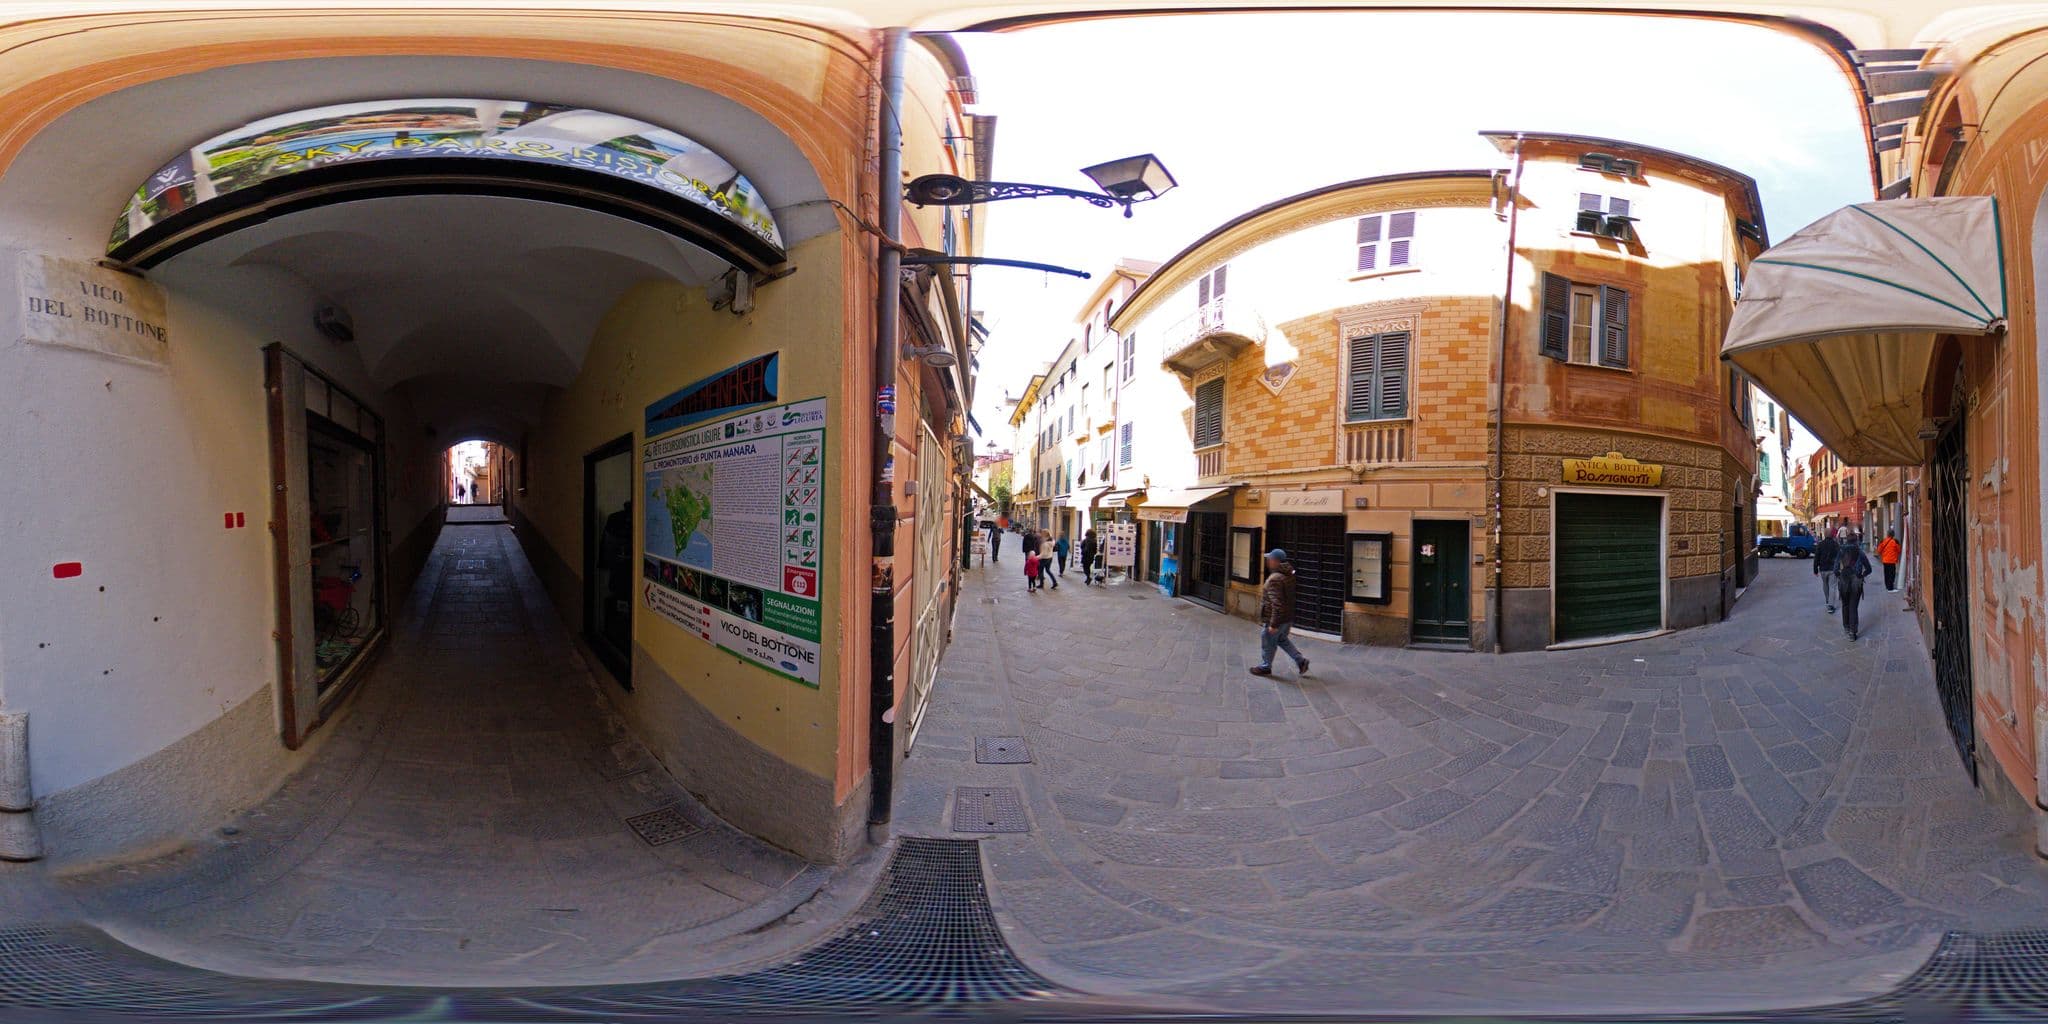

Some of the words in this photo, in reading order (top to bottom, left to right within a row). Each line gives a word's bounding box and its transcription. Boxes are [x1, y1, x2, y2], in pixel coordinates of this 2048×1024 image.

[277, 140, 376, 166] SKY
[393, 136, 508, 150] BAR
[510, 140, 568, 162] &
[80, 281, 123, 304] VICO
[29, 297, 72, 318] DEL
[84, 306, 167, 343] BOTTONE
[702, 359, 765, 410] MANARA
[794, 414, 824, 424] LIGURIA
[701, 427, 721, 445] LIGURE
[657, 455, 692, 469] PROMONTORIO
[700, 450, 721, 462] PUNTA
[723, 443, 757, 458] MANARA
[1574, 461, 1608, 470] ANTICA
[1614, 463, 1654, 474] BOTTEGA
[786, 568, 814, 577] Emergenza
[766, 597, 816, 617] SEGNALAZIONI
[720, 620, 741, 636] VICO
[742, 629, 760, 645] DEL
[761, 636, 815, 665] BOTTONE
[747, 646, 754, 654] m
[754, 648, 759, 656] 2
